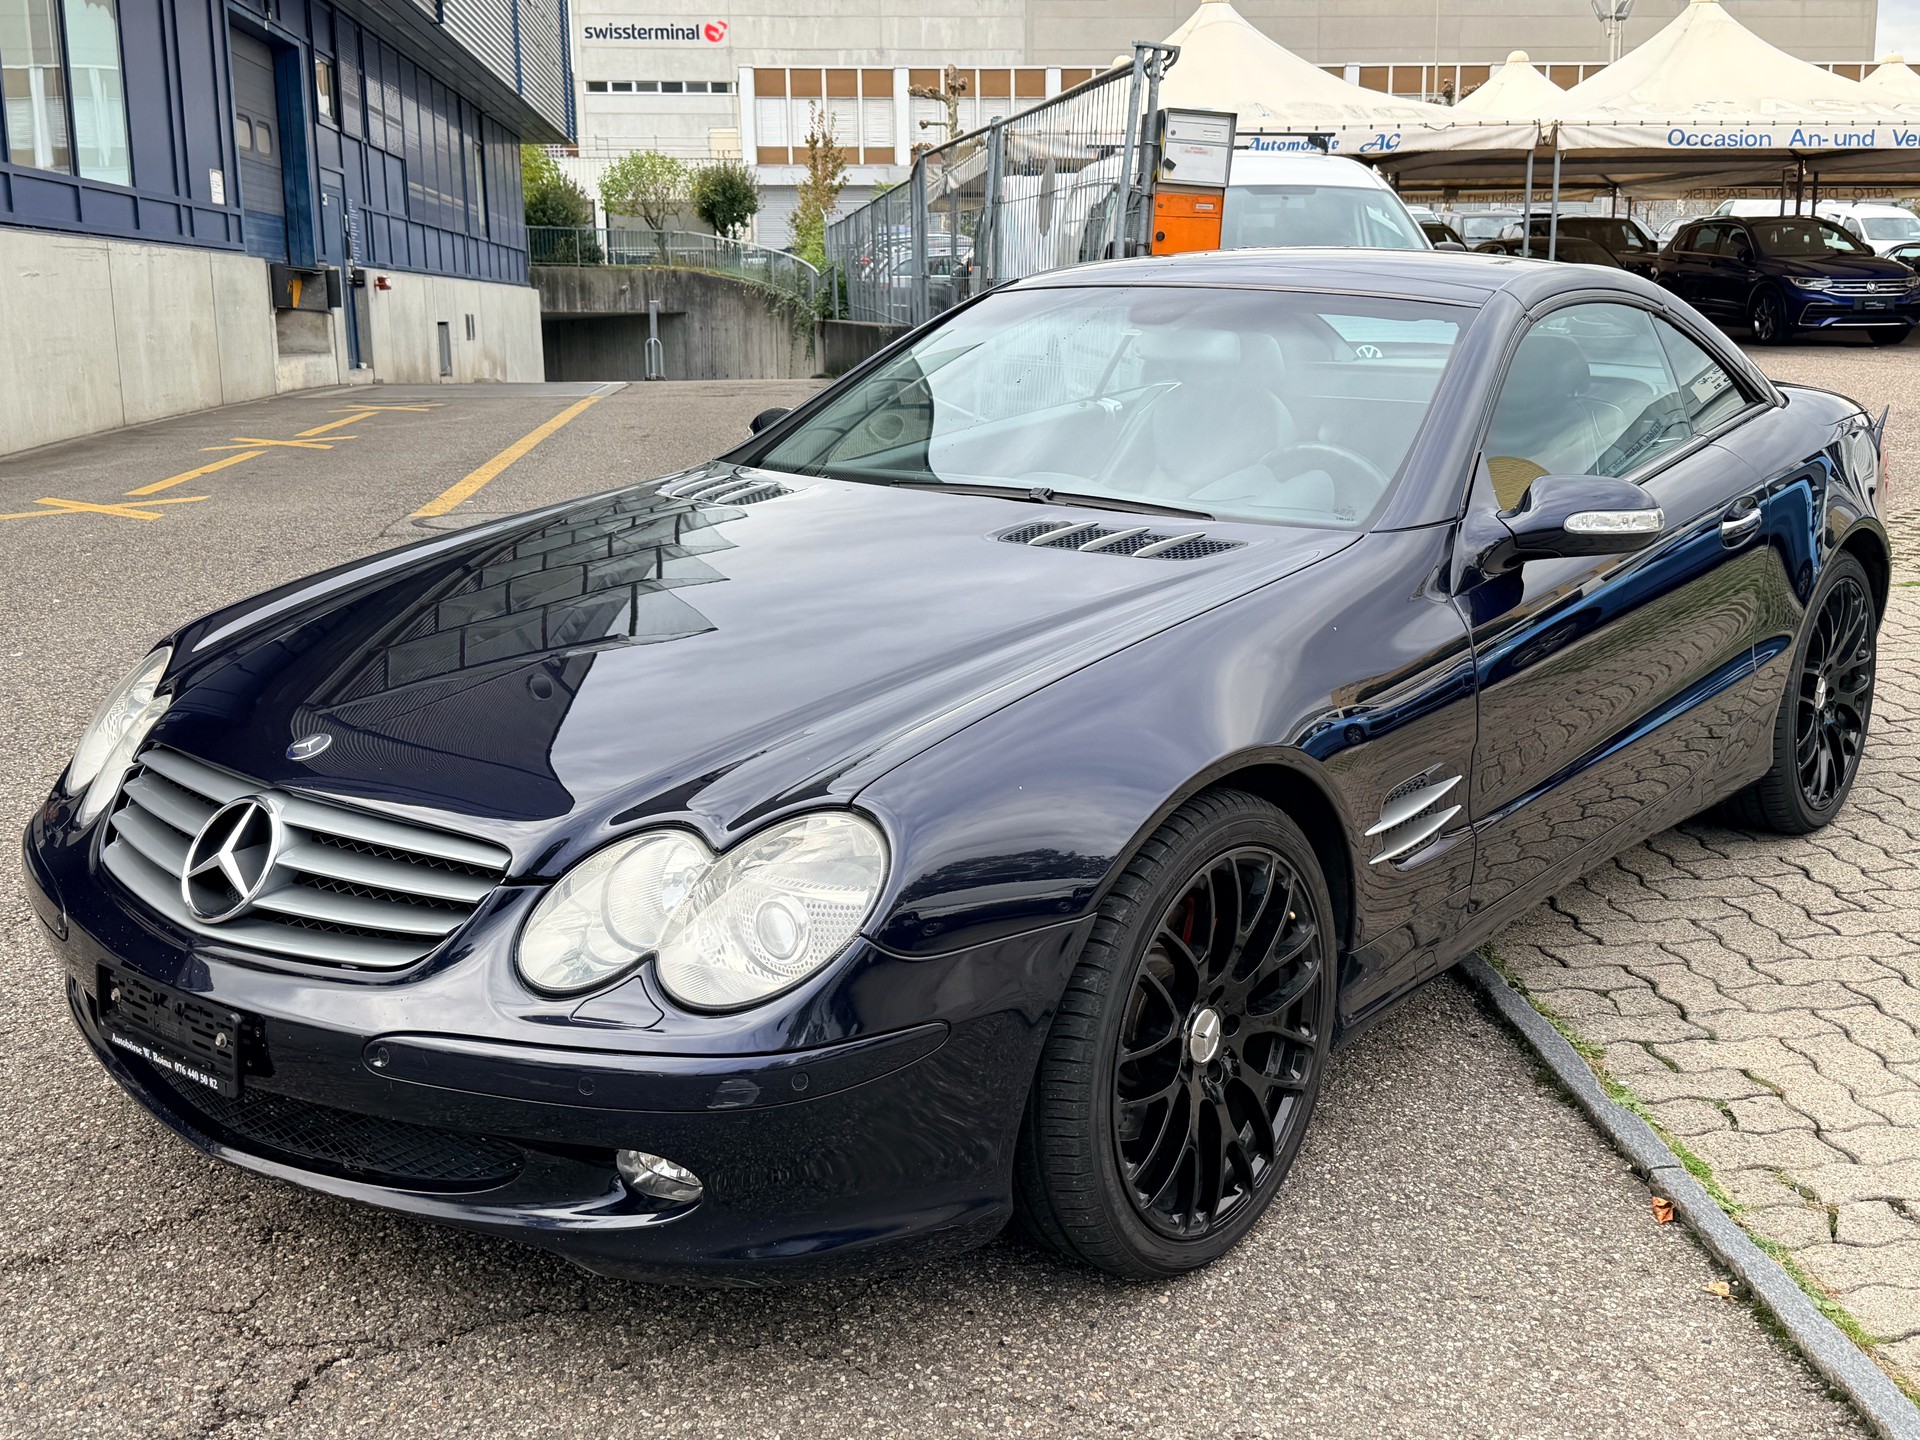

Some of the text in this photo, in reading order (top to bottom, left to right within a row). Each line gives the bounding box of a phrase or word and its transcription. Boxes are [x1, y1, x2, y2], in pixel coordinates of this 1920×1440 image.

[584, 23, 700, 40] swissterminal
[1249, 133, 1401, 153] Automole AG
[1667, 128, 1772, 148] Occasion
[1892, 129, 1920, 147] Ve
[111, 1032, 143, 1055] Autobörse
[142, 1046, 152, 1060] W.
[174, 1061, 187, 1076] 076
[187, 1068, 199, 1081] 440
[199, 1073, 209, 1086] 50
[208, 1077, 218, 1090] 82
